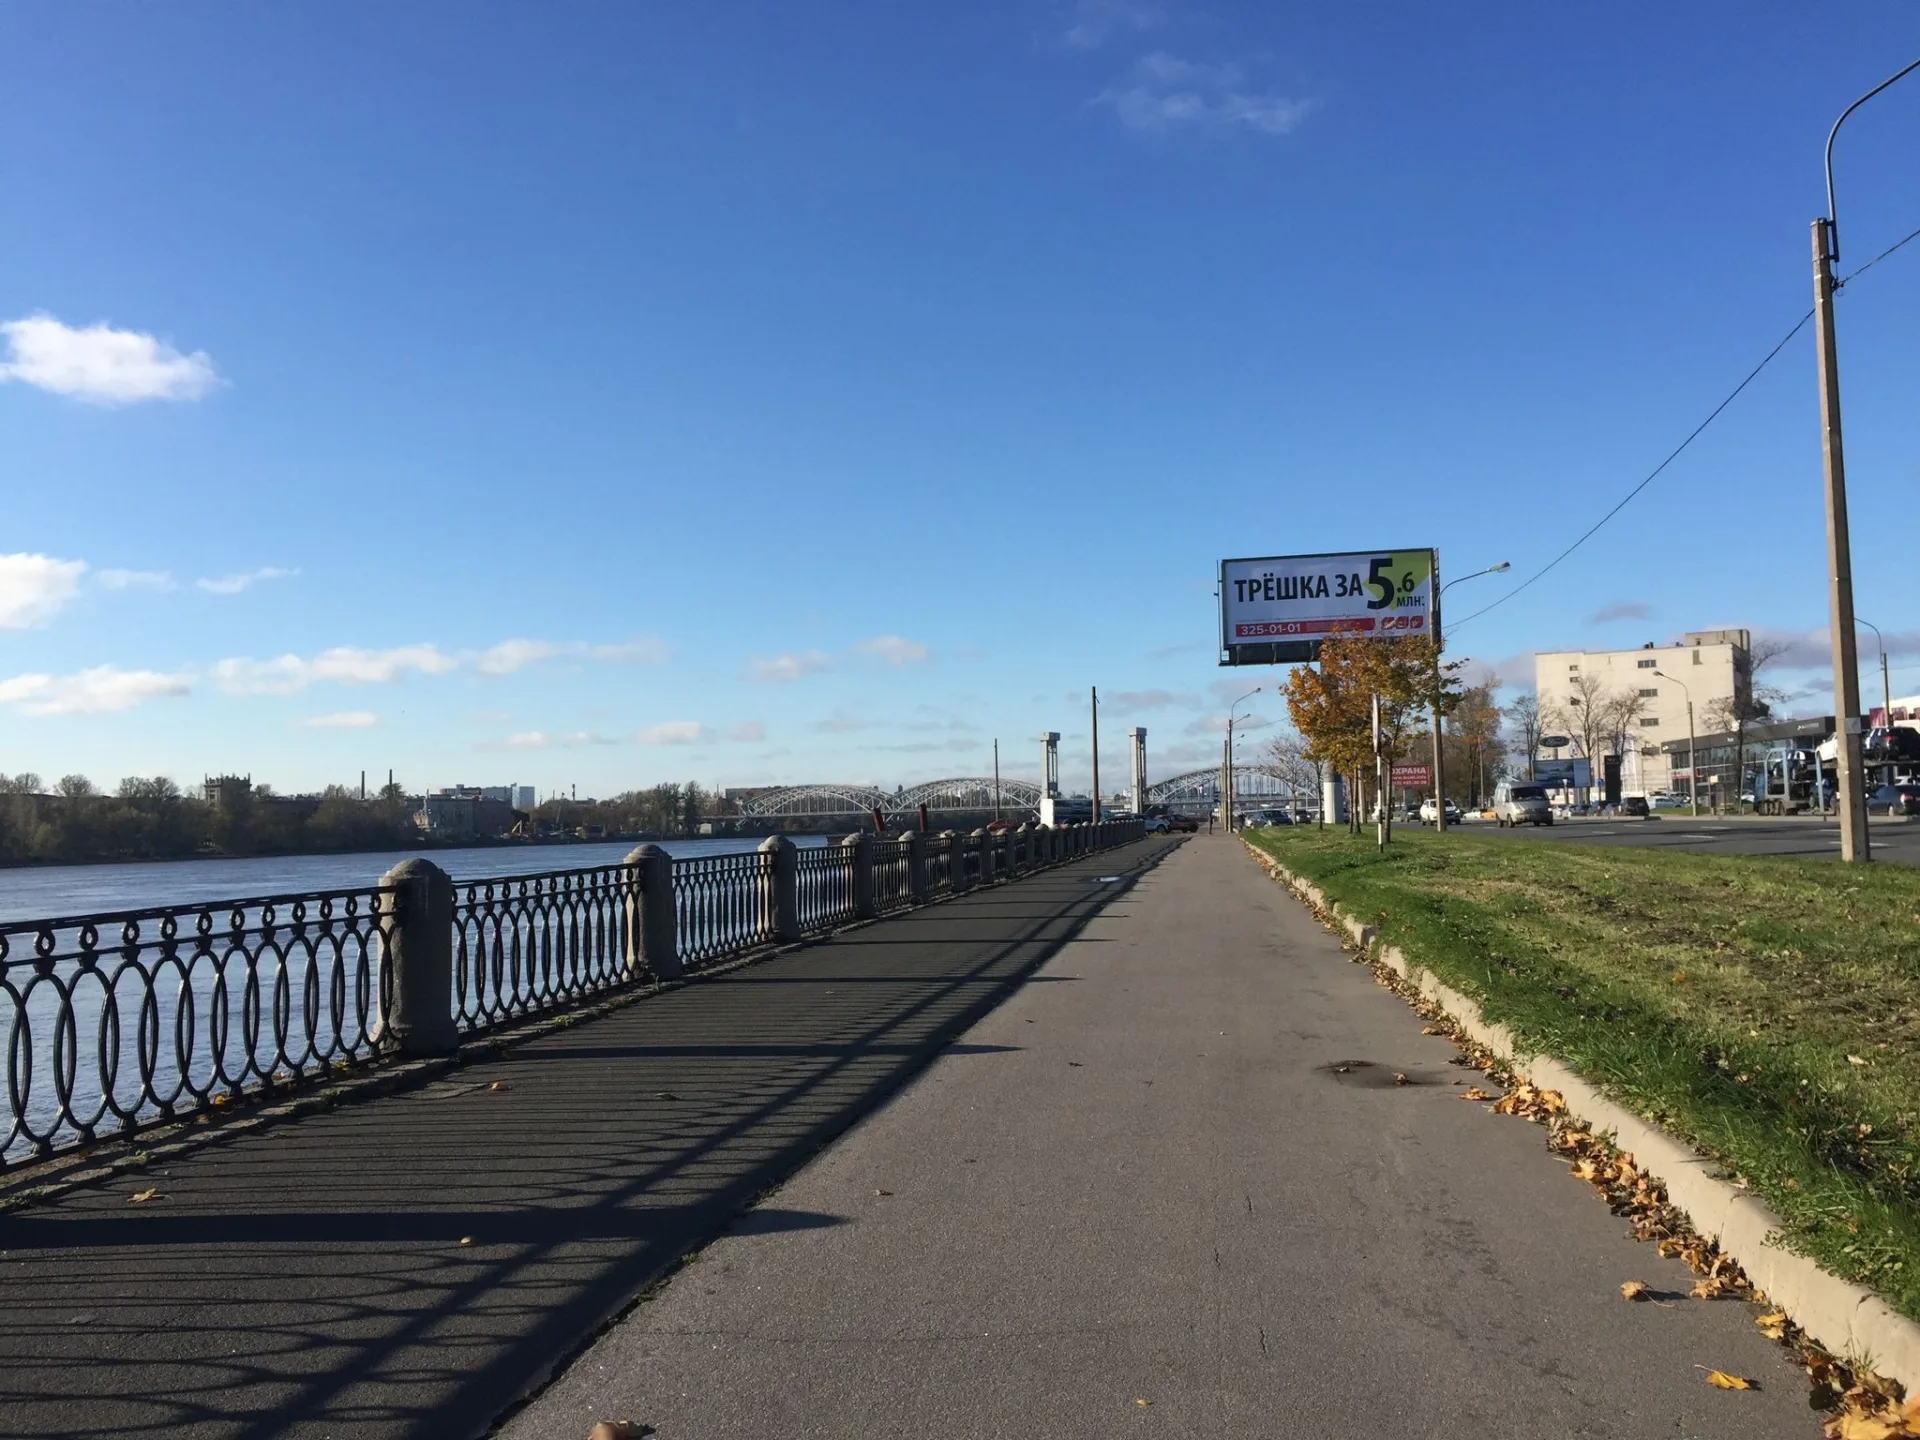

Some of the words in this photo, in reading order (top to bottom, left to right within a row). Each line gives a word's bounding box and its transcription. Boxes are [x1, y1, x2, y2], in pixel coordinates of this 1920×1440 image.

[1234, 573, 1330, 602] ТРЁШКА
[1335, 573, 1364, 597] ЗА
[1240, 622, 1301, 636] 325-01-01
